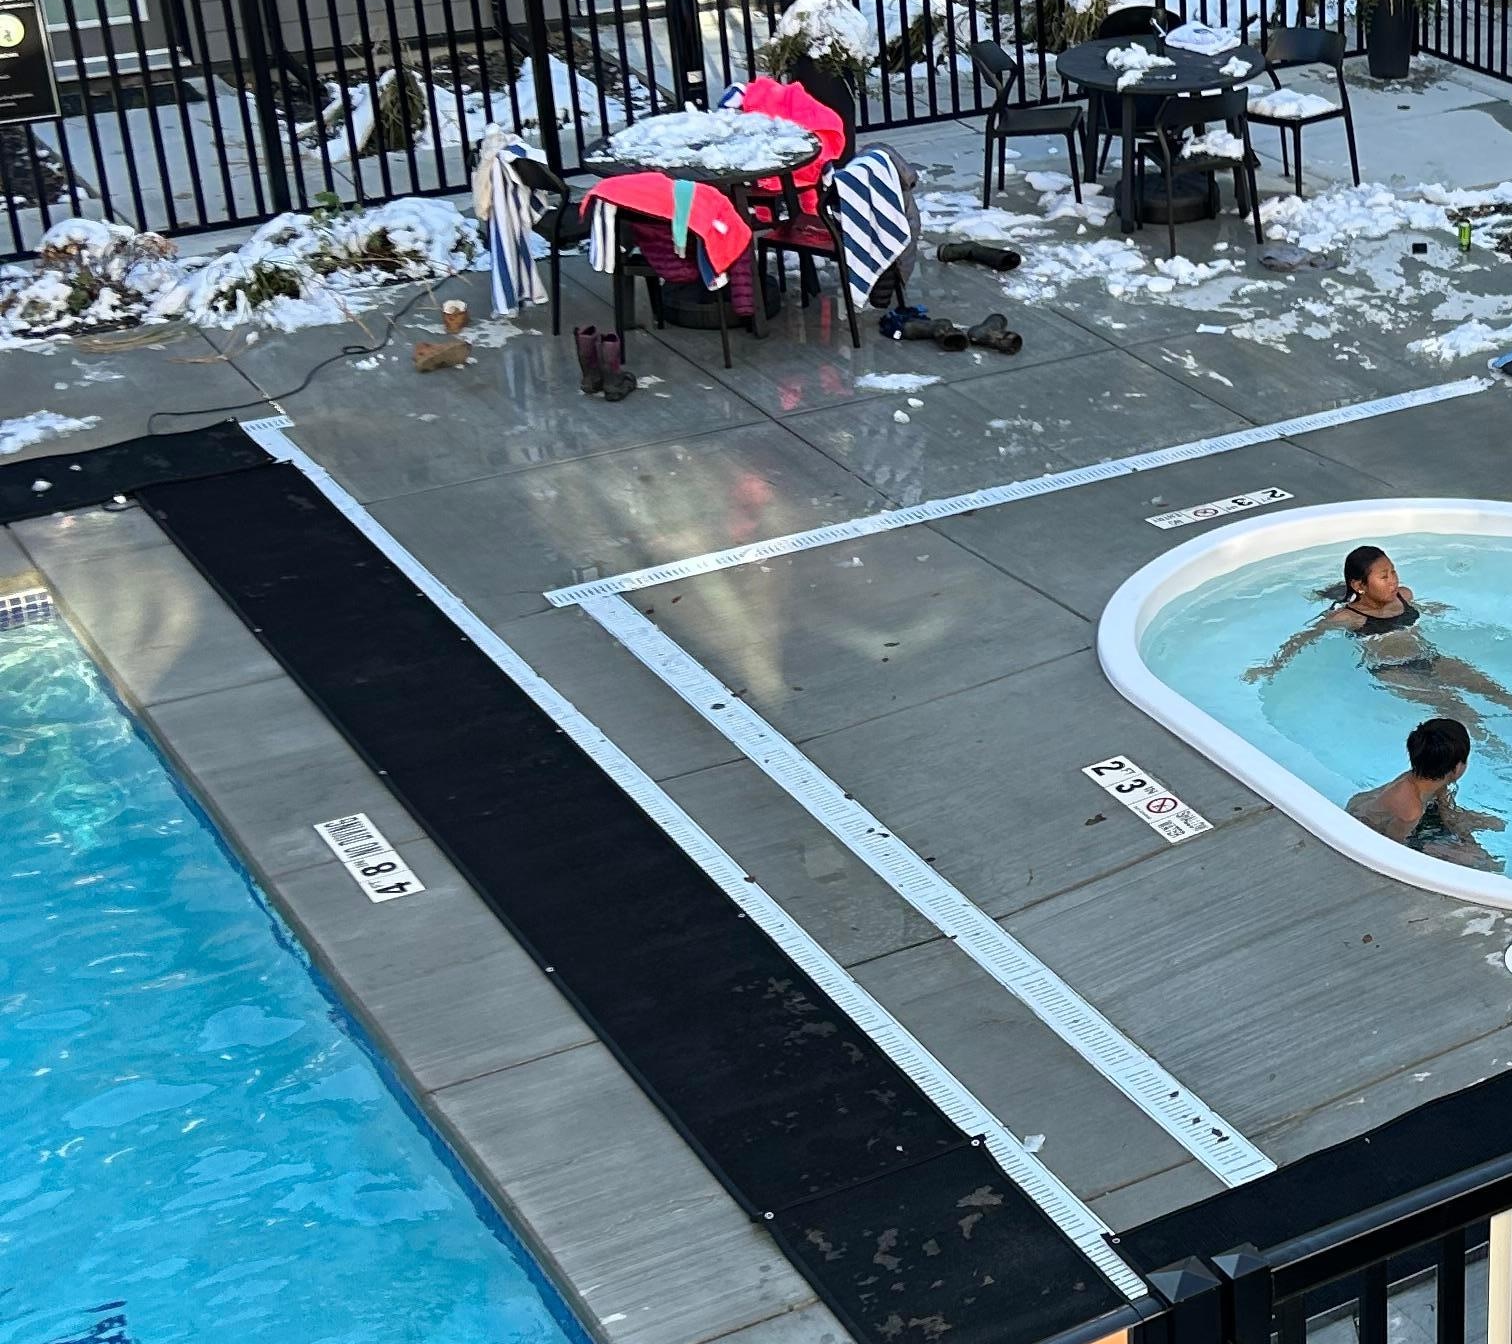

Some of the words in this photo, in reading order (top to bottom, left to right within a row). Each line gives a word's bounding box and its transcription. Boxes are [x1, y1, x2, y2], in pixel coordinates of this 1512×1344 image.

[1262, 488, 1286, 499] 2
[1231, 497, 1254, 507] 3
[1091, 760, 1126, 777] 2
[1115, 778, 1147, 794] 3
[324, 816, 374, 847] DIVING
[344, 842, 385, 859] NO
[361, 861, 397, 877] 8
[375, 880, 412, 895] 4
